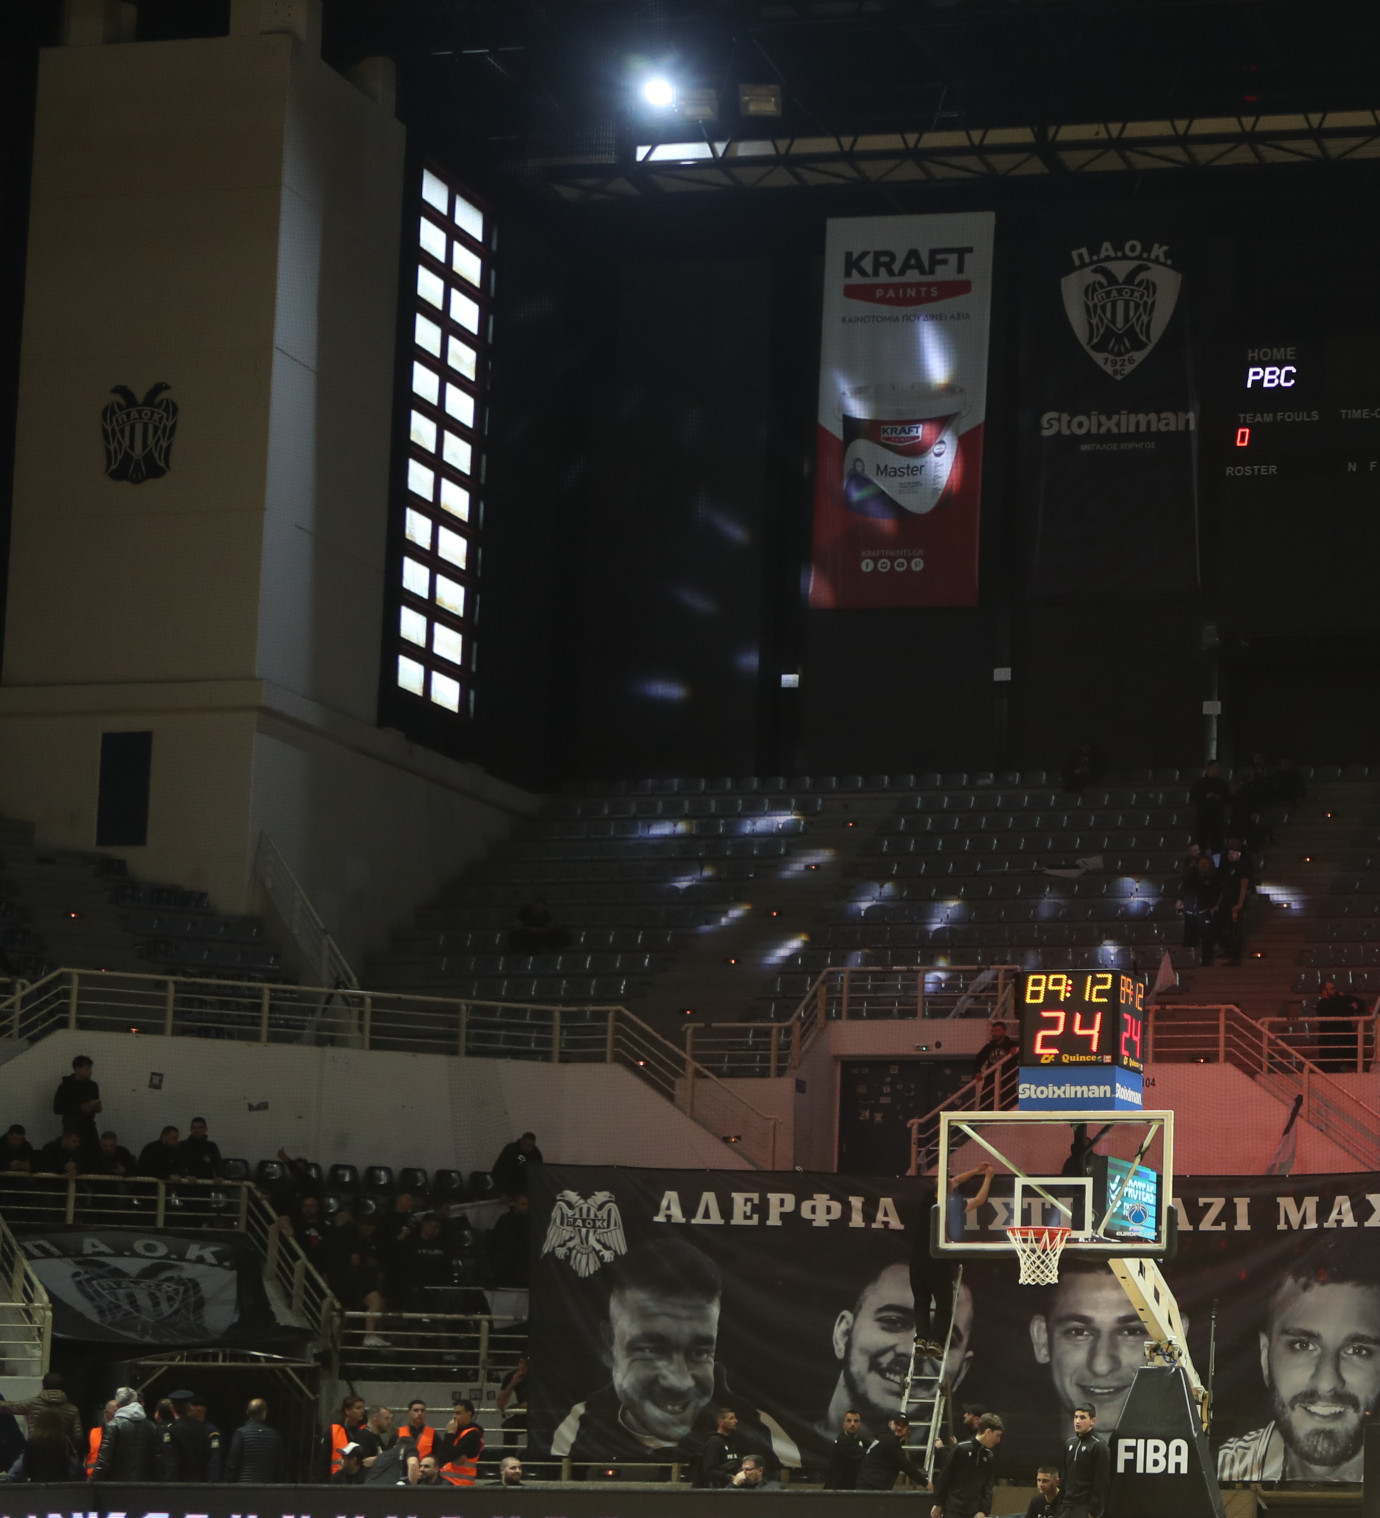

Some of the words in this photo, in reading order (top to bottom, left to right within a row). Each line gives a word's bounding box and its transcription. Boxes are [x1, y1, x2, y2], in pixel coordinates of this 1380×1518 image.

[1071, 240, 1173, 267] Π.Α.Ο.Κ.
[844, 247, 974, 279] KRAFT
[876, 286, 940, 299] PAINTS
[1097, 288, 1145, 303] ΠΑΟΚ
[1247, 347, 1297, 362] HOME
[1103, 357, 1136, 368] 1926
[1112, 369, 1126, 377] BC
[1246, 366, 1297, 389] PBC
[118, 410, 162, 425] ΠΑΟΚ
[1040, 411, 1196, 437] Stoiximan
[1238, 412, 1274, 424] TEAM
[1277, 410, 1320, 423] FOULS
[882, 426, 921, 435] KRAFT
[1235, 427, 1250, 447] 0
[876, 463, 925, 478] Master
[1225, 465, 1278, 477] ROSTER
[1347, 462, 1357, 472] N
[1370, 461, 1377, 471] F
[1025, 973, 1113, 1004] 89:12
[1034, 1011, 1102, 1055] 24
[1120, 1013, 1142, 1059] 24
[1019, 1083, 1112, 1099] Stoiximan
[653, 1191, 905, 1230] ΑΔΕΡΦΙΑ
[1117, 1438, 1189, 1475] FIBA
